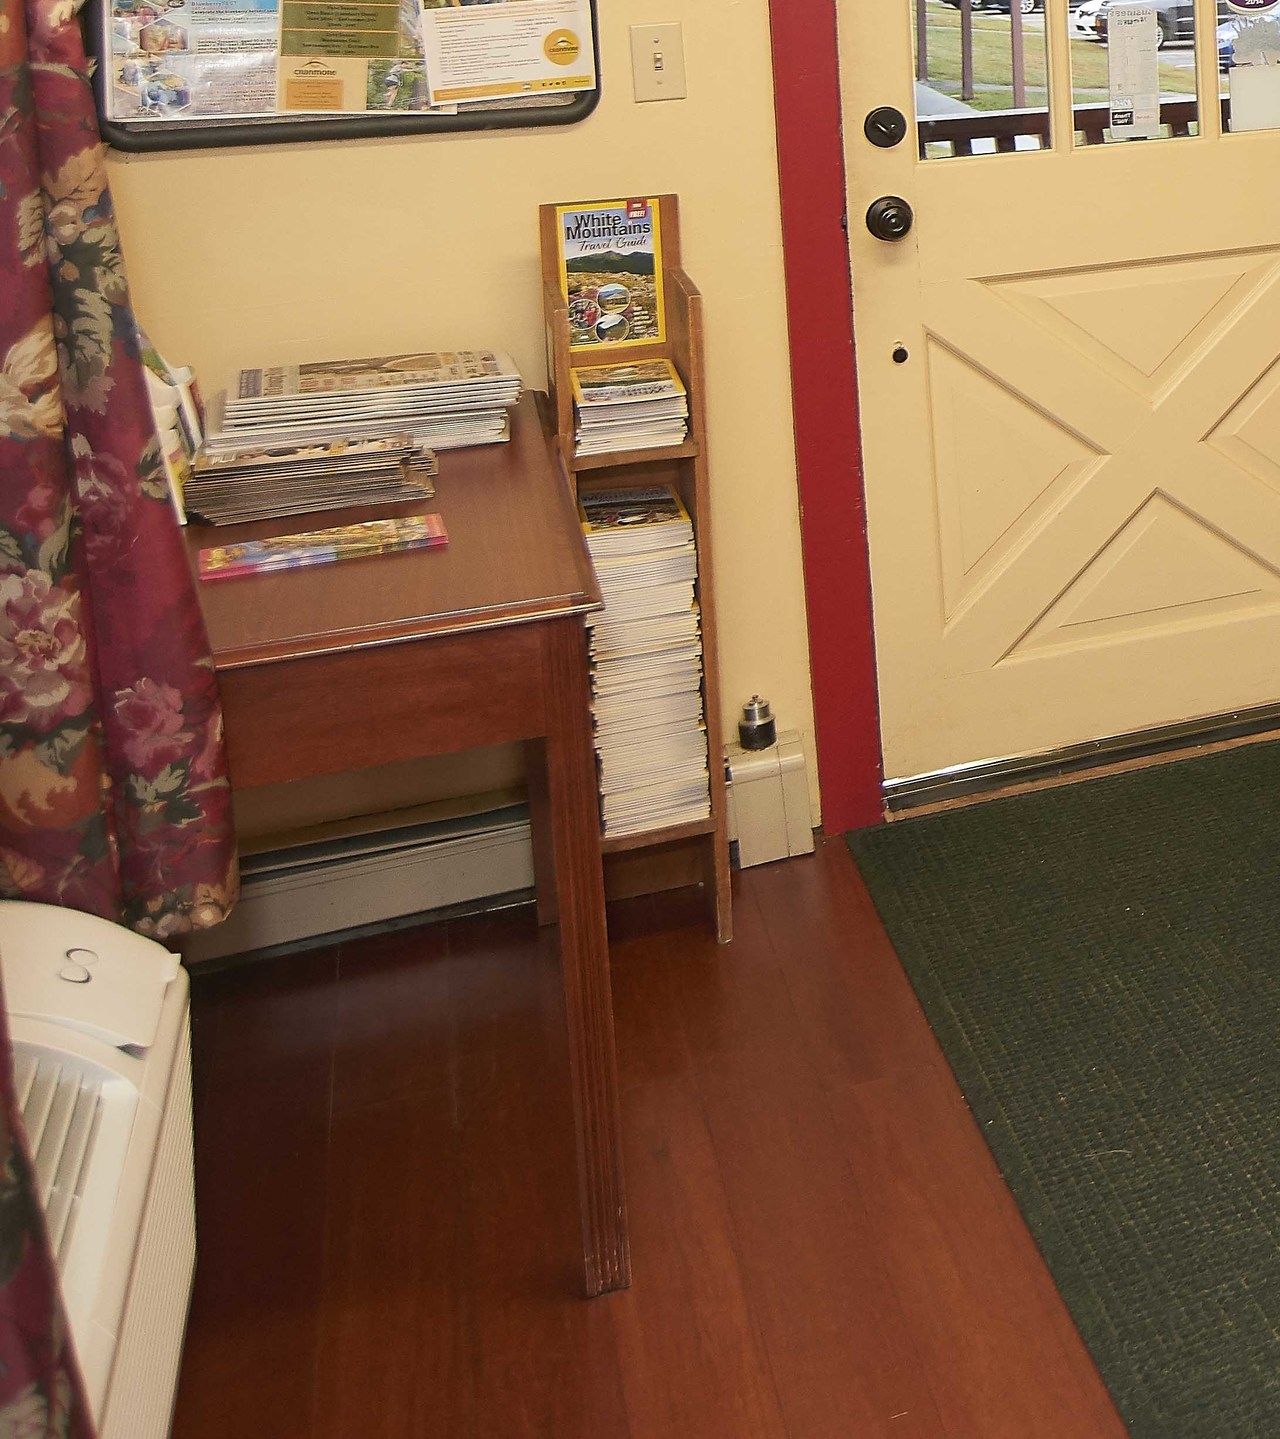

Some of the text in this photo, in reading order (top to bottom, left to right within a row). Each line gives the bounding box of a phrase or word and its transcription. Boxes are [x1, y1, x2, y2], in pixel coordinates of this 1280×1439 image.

[574, 213, 621, 228] White
[566, 222, 651, 240] Mountains
[577, 239, 612, 251] Travel
